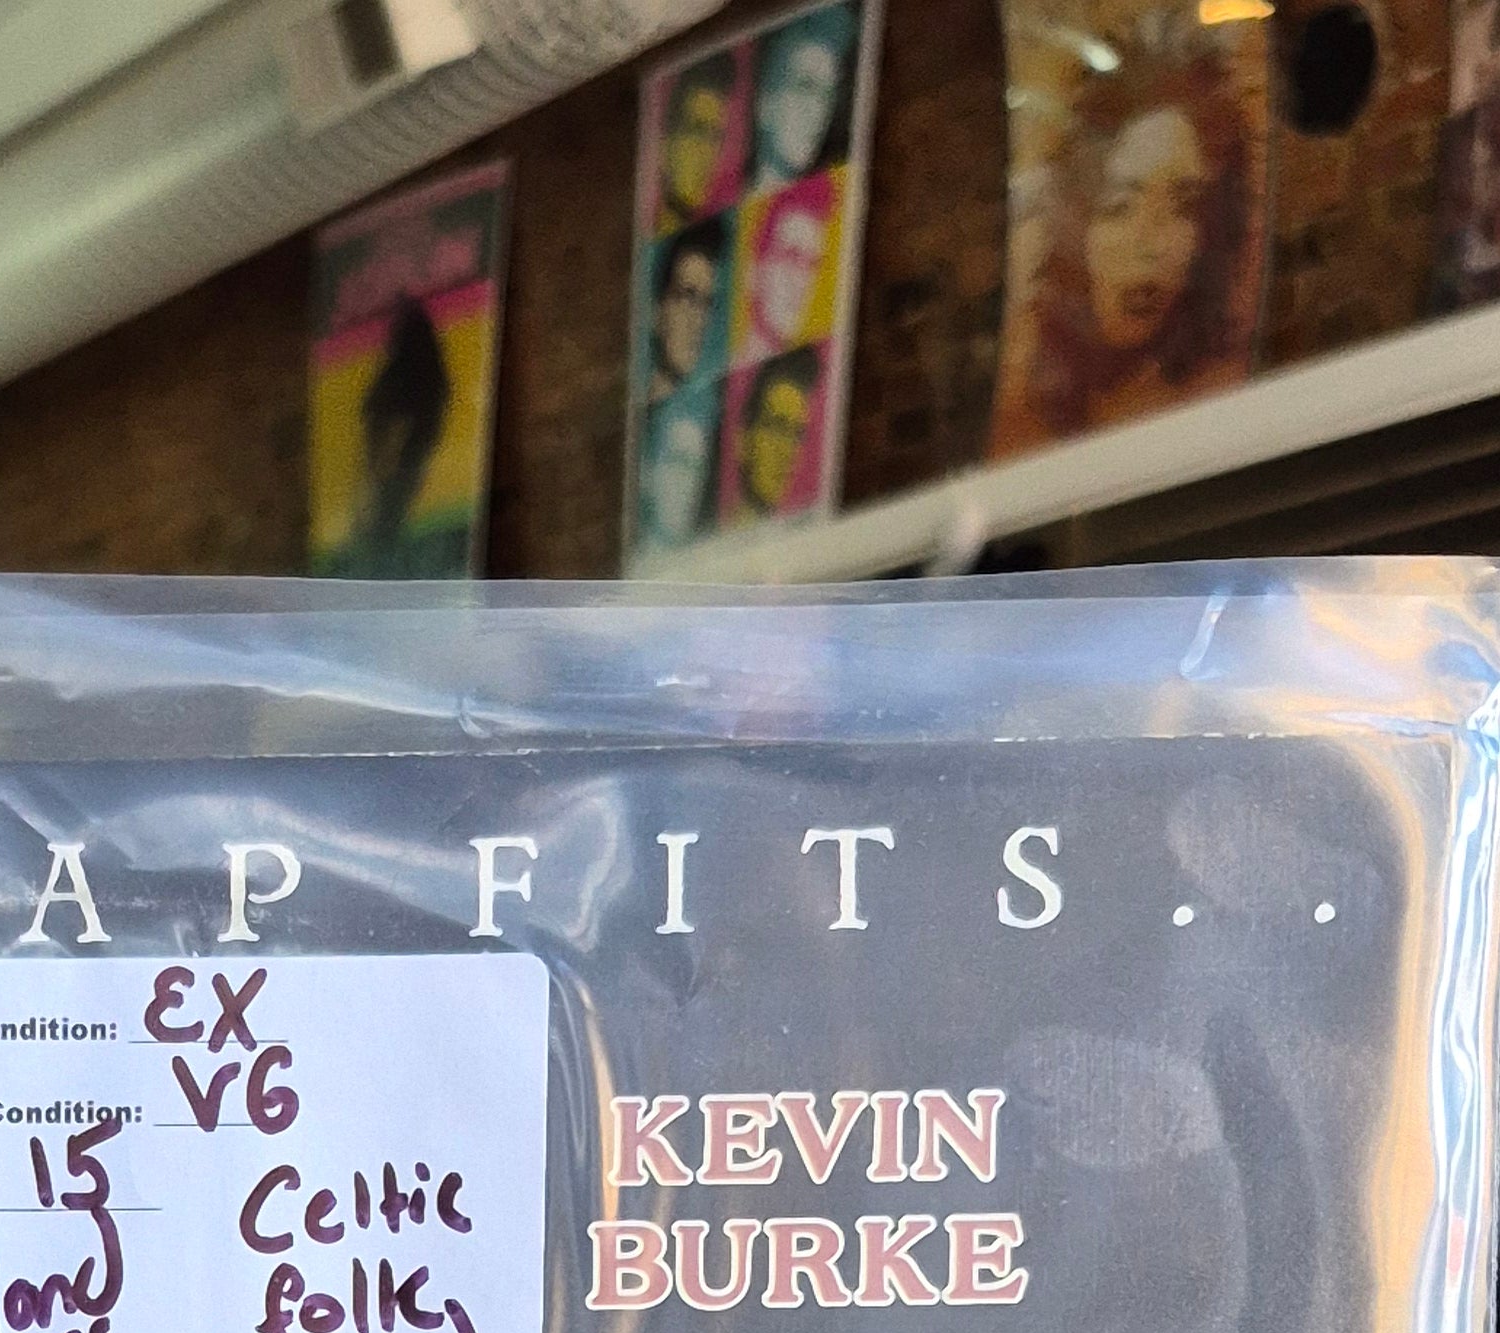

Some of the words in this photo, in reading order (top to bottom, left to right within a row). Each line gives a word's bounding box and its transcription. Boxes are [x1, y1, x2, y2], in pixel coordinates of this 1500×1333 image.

[144, 965, 268, 1053] EX
[29, 1117, 124, 1211] 15
[608, 1088, 1006, 1187] KEVIN
[239, 1162, 473, 1254] Celtic
[585, 1213, 1030, 1311] BURKE
